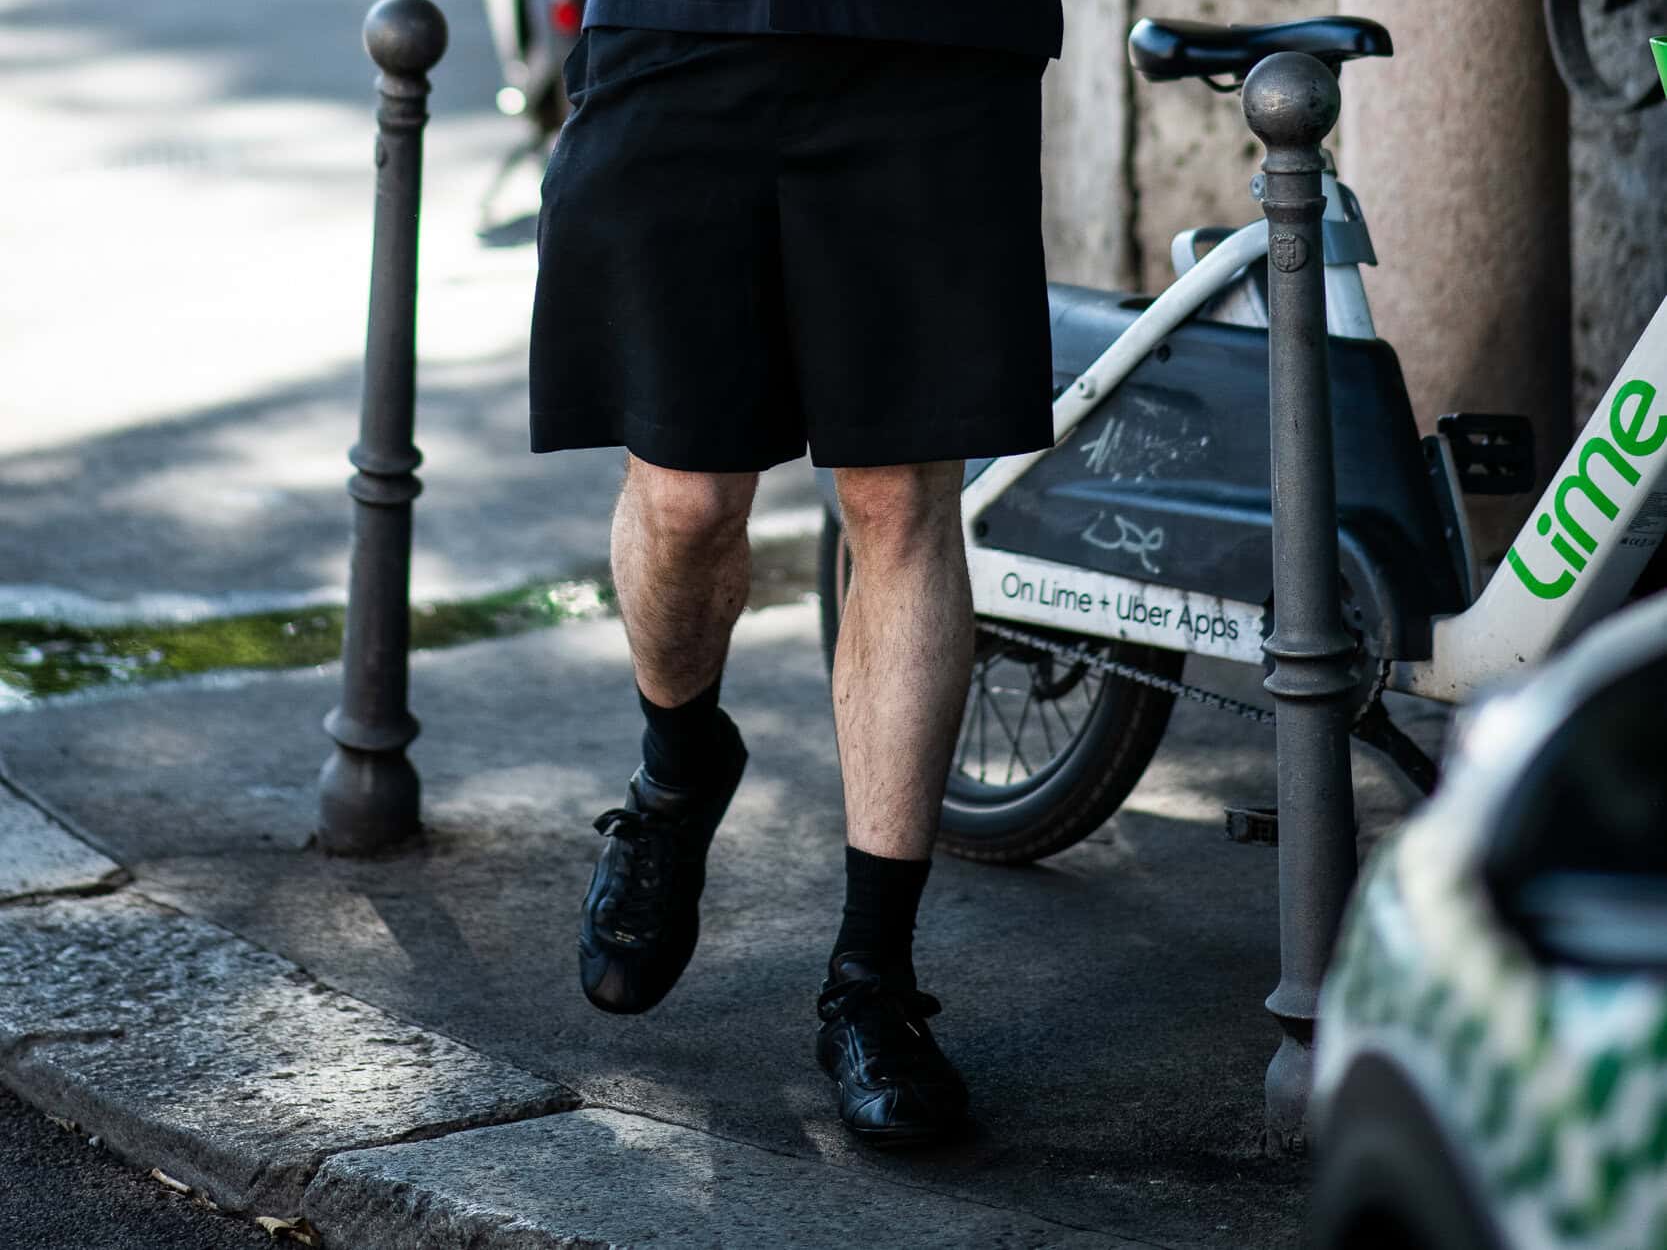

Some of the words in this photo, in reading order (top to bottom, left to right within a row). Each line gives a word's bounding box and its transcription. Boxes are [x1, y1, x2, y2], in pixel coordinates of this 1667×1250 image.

[1506, 379, 1667, 600] Lime
[1001, 572, 1035, 601] On
[1039, 579, 1093, 613] Lime
[1098, 597, 1110, 611] +
[1116, 593, 1173, 628] Uber
[1175, 603, 1240, 643] Apps
